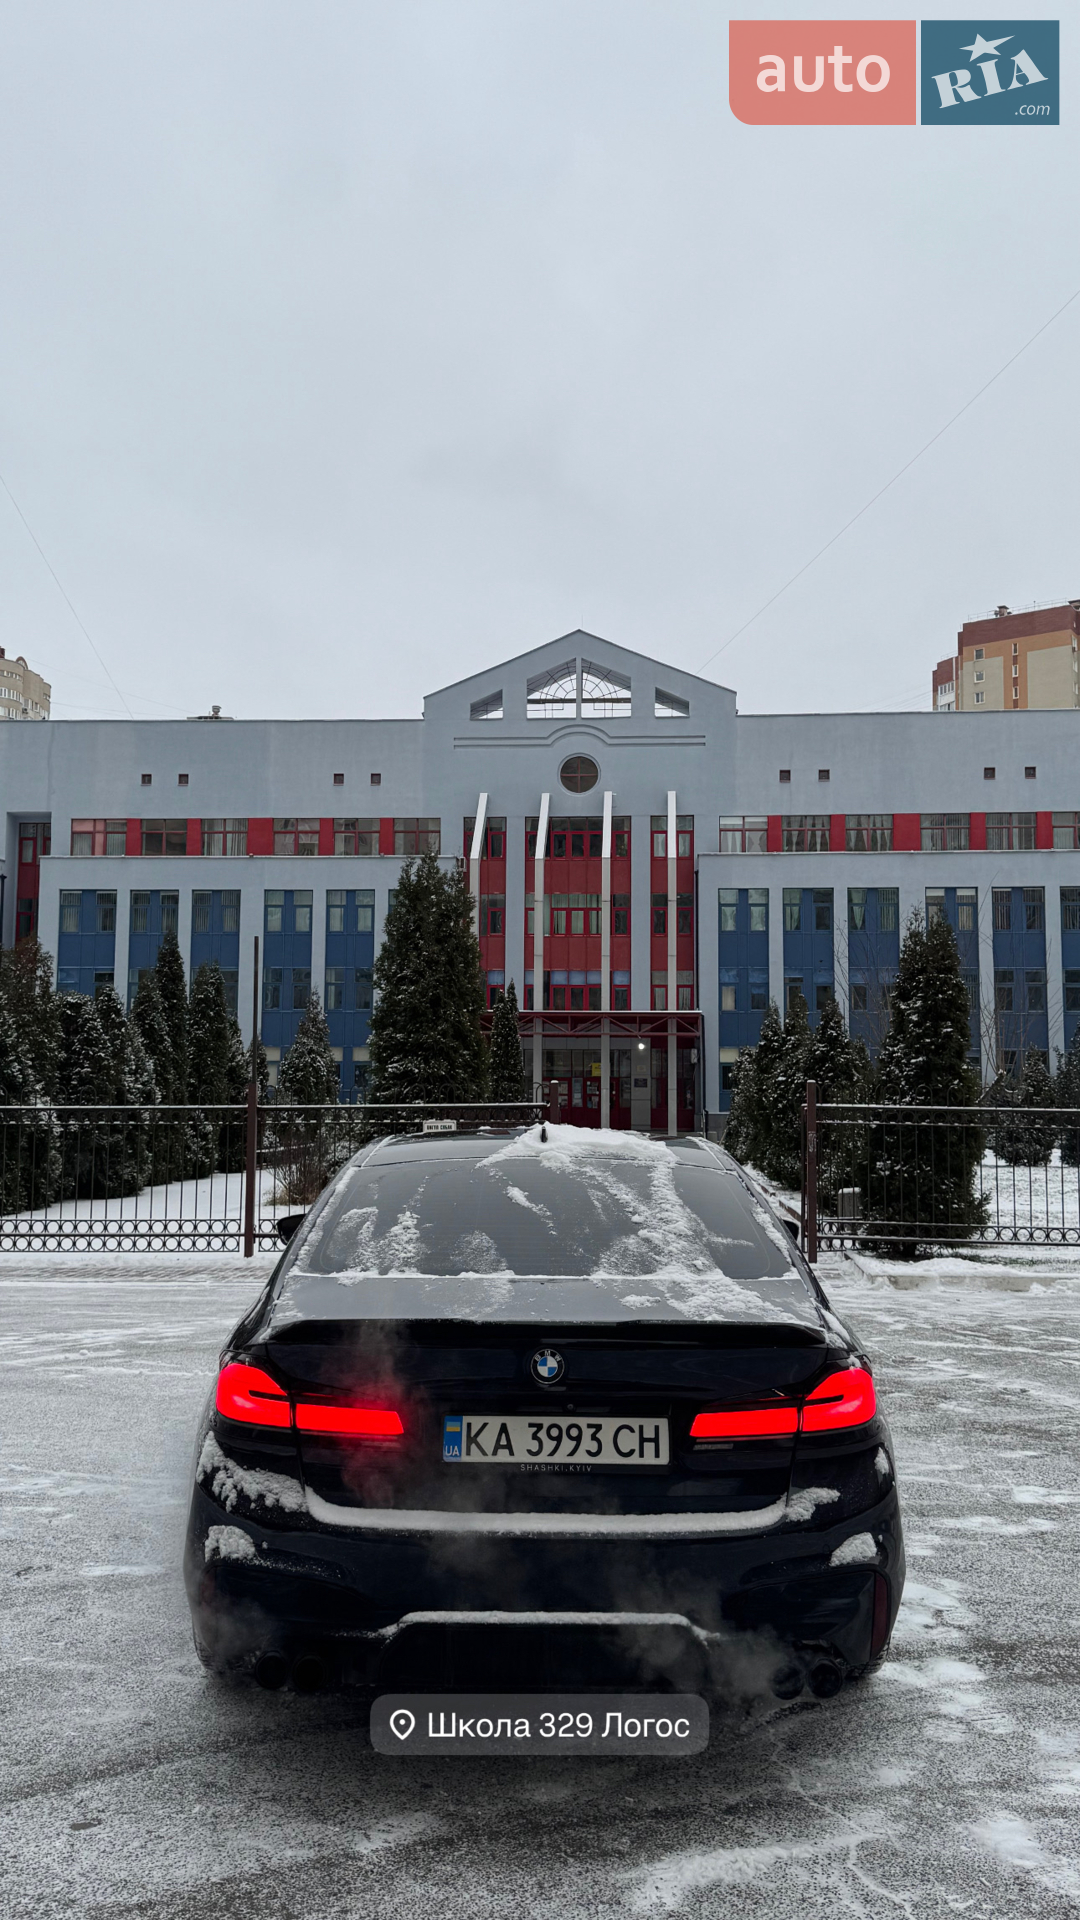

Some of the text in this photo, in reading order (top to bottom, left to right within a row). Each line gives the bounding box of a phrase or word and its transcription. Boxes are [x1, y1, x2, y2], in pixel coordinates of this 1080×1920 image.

[534, 1350, 562, 1362] BMW
[465, 1422, 661, 1459] KA 3993 CH
[445, 1445, 460, 1457] UA
